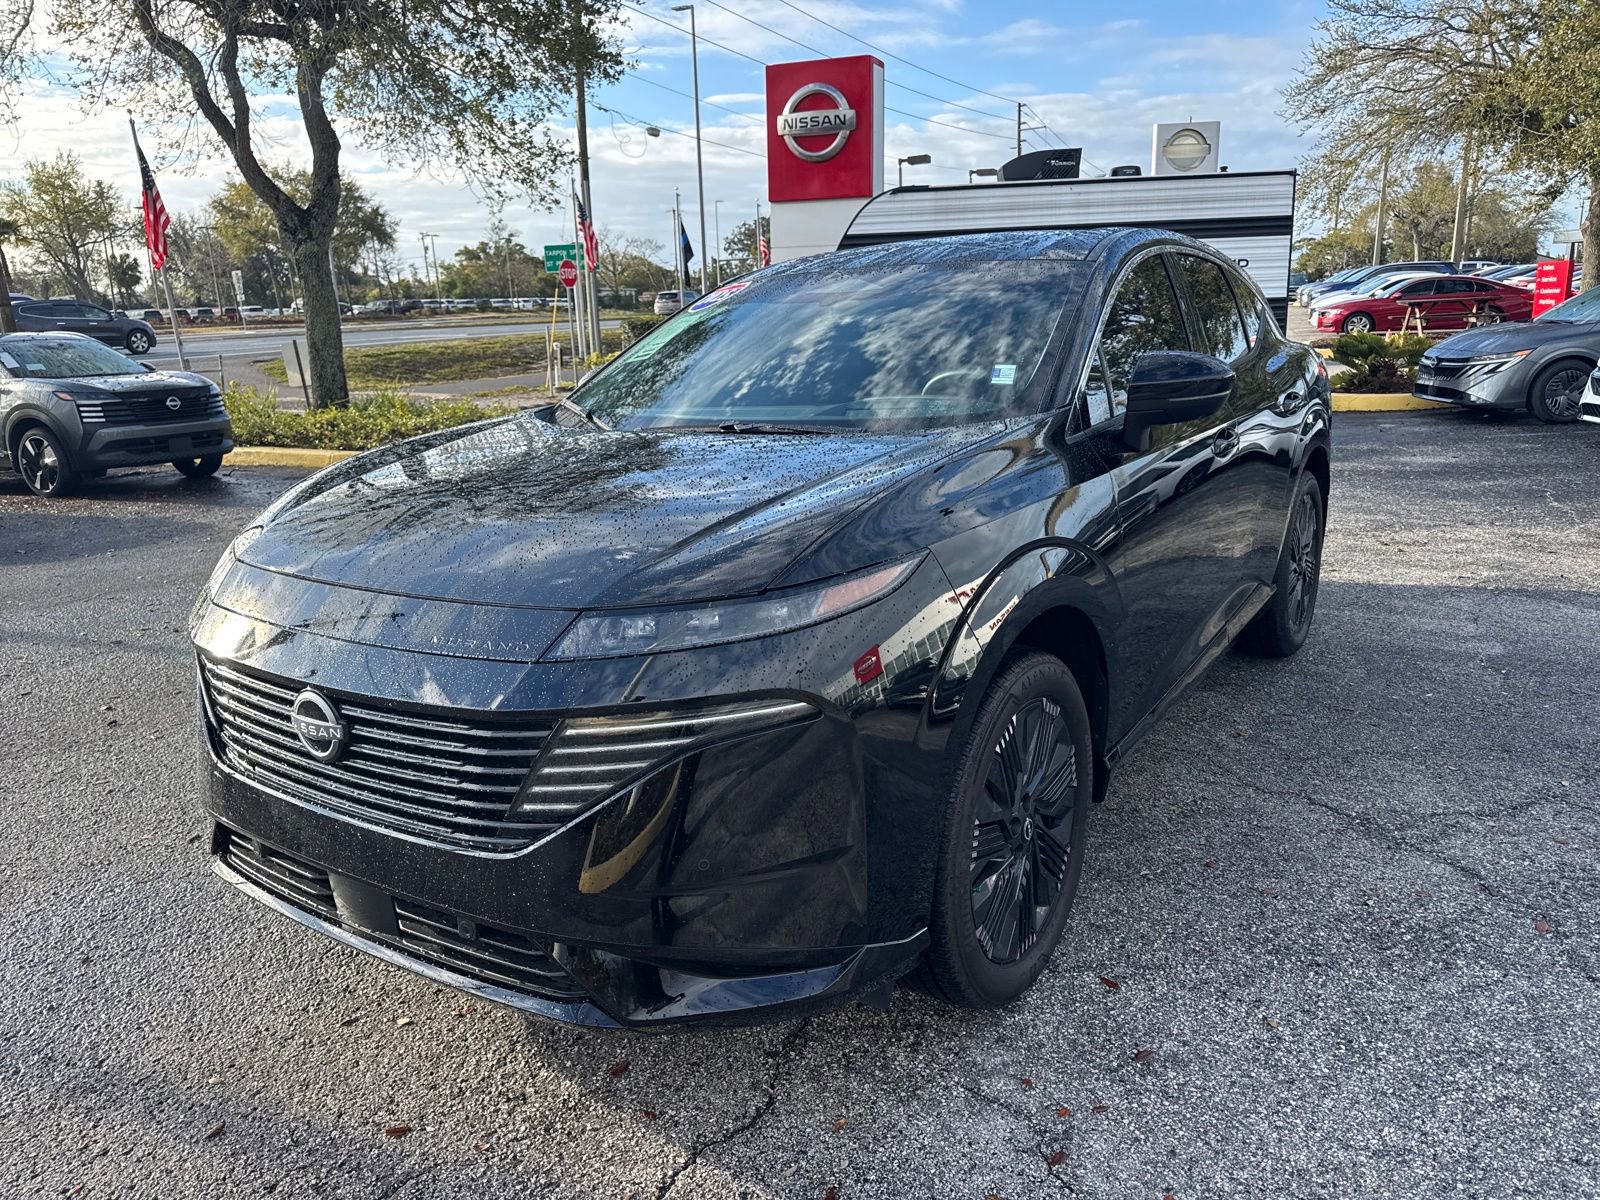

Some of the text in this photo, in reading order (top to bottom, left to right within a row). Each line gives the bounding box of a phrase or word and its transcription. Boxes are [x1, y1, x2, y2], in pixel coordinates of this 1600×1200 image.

[783, 114, 846, 130] NISSAN
[560, 268, 576, 279] STOP
[292, 720, 341, 738] SSAN
